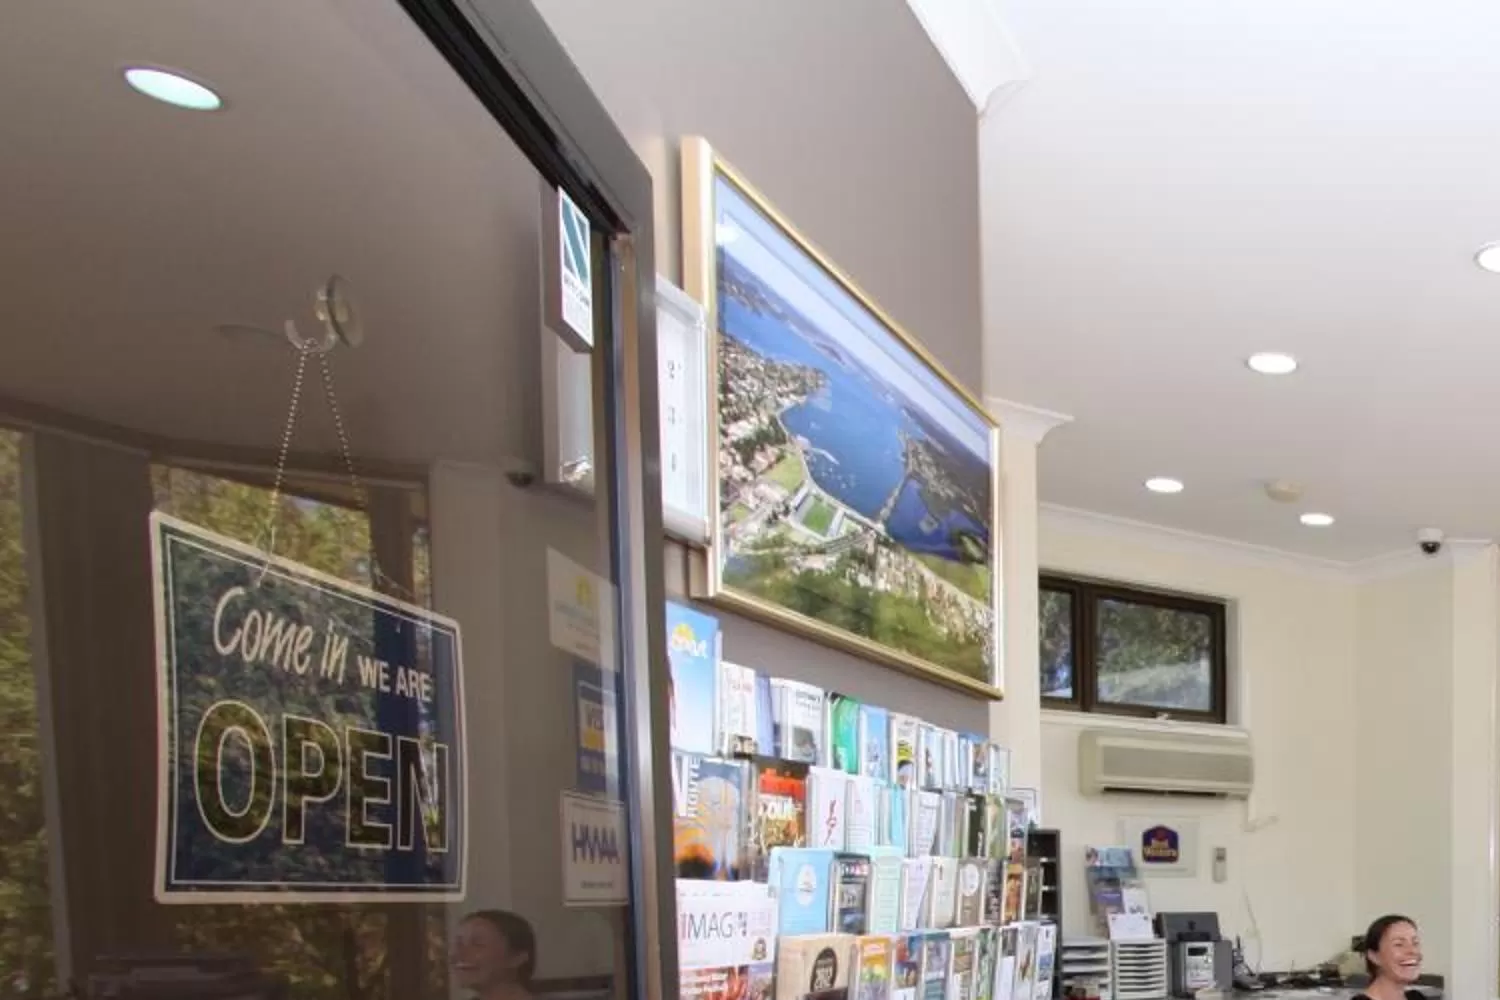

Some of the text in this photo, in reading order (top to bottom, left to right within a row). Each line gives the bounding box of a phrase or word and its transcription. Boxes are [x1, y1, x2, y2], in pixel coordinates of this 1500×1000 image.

[213, 586, 433, 702] Come in WE ARE
[194, 699, 449, 854] OPEN
